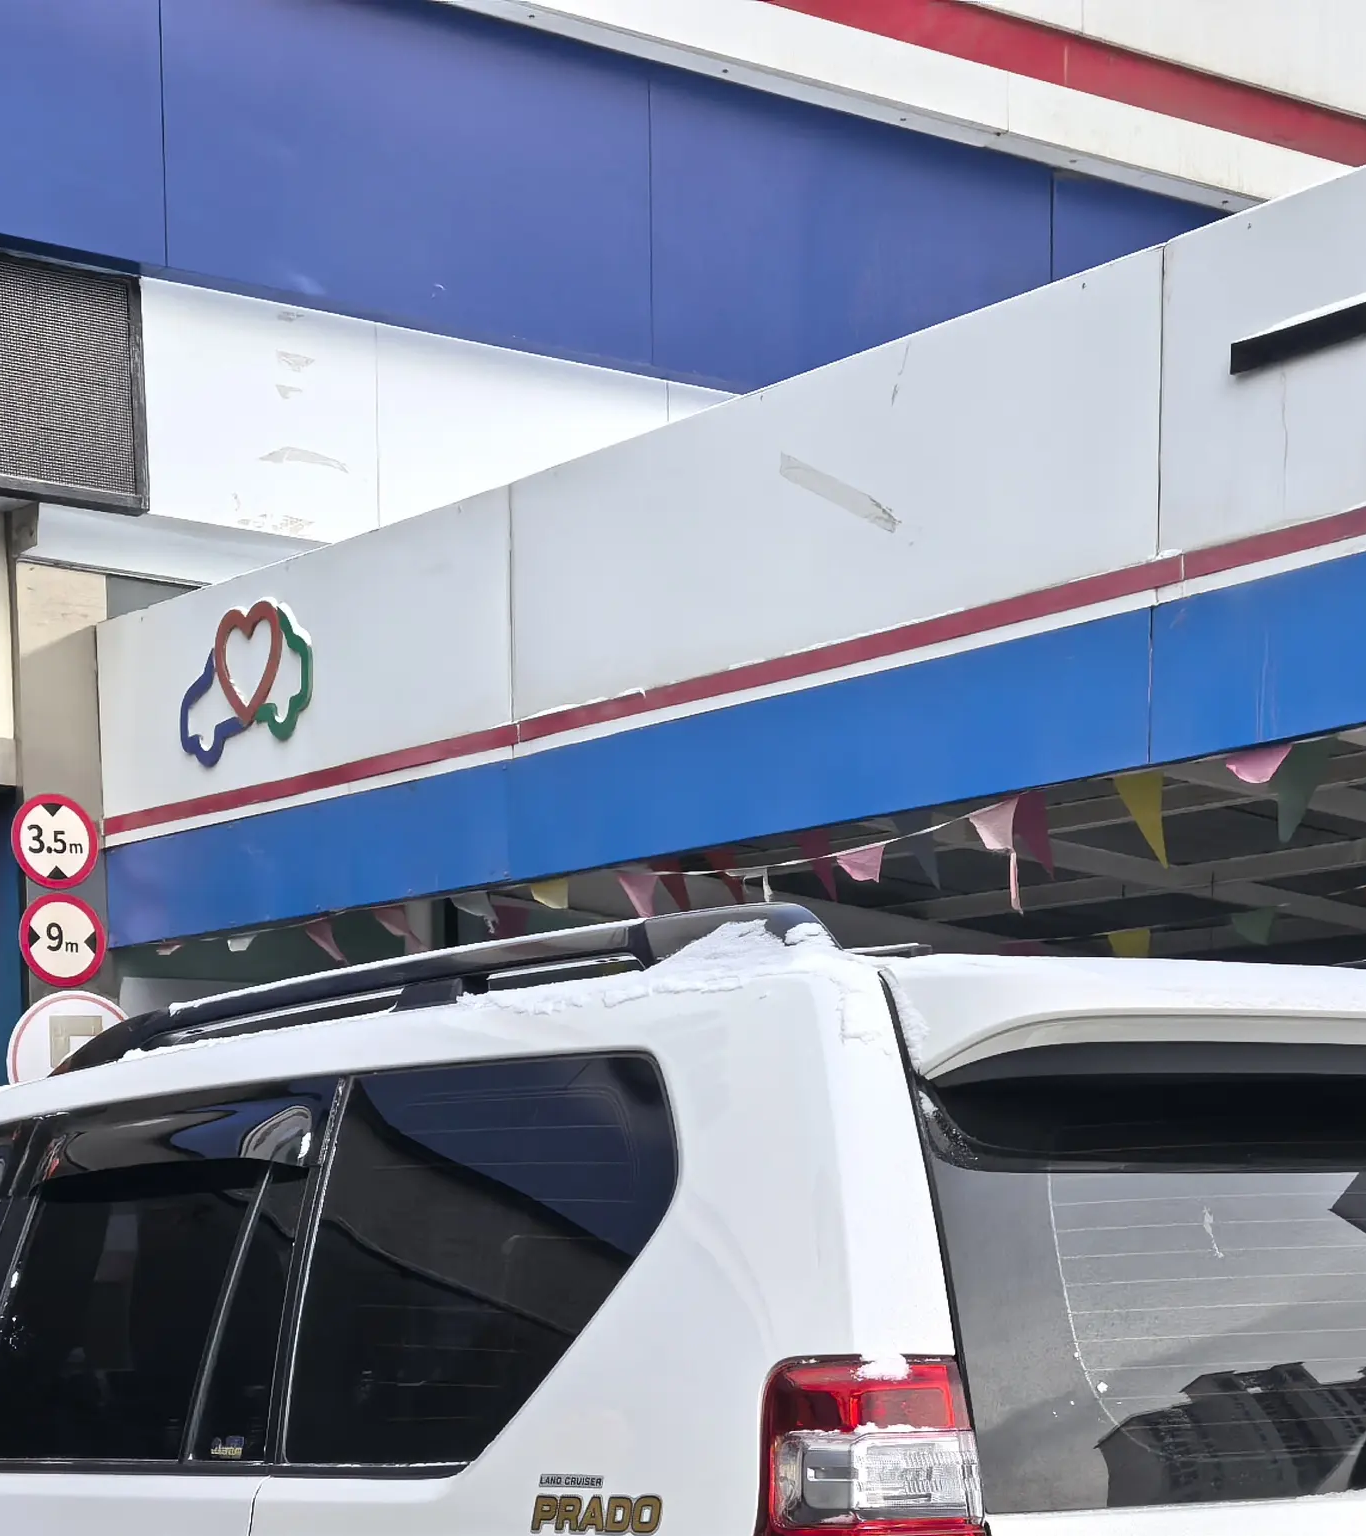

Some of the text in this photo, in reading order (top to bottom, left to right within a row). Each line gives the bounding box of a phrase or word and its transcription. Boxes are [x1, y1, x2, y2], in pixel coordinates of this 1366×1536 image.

[27, 824, 84, 854] 3.5m
[46, 922, 79, 954] 9m
[539, 1475, 603, 1487] LAND CRUISER
[530, 1492, 663, 1536] PRADO
